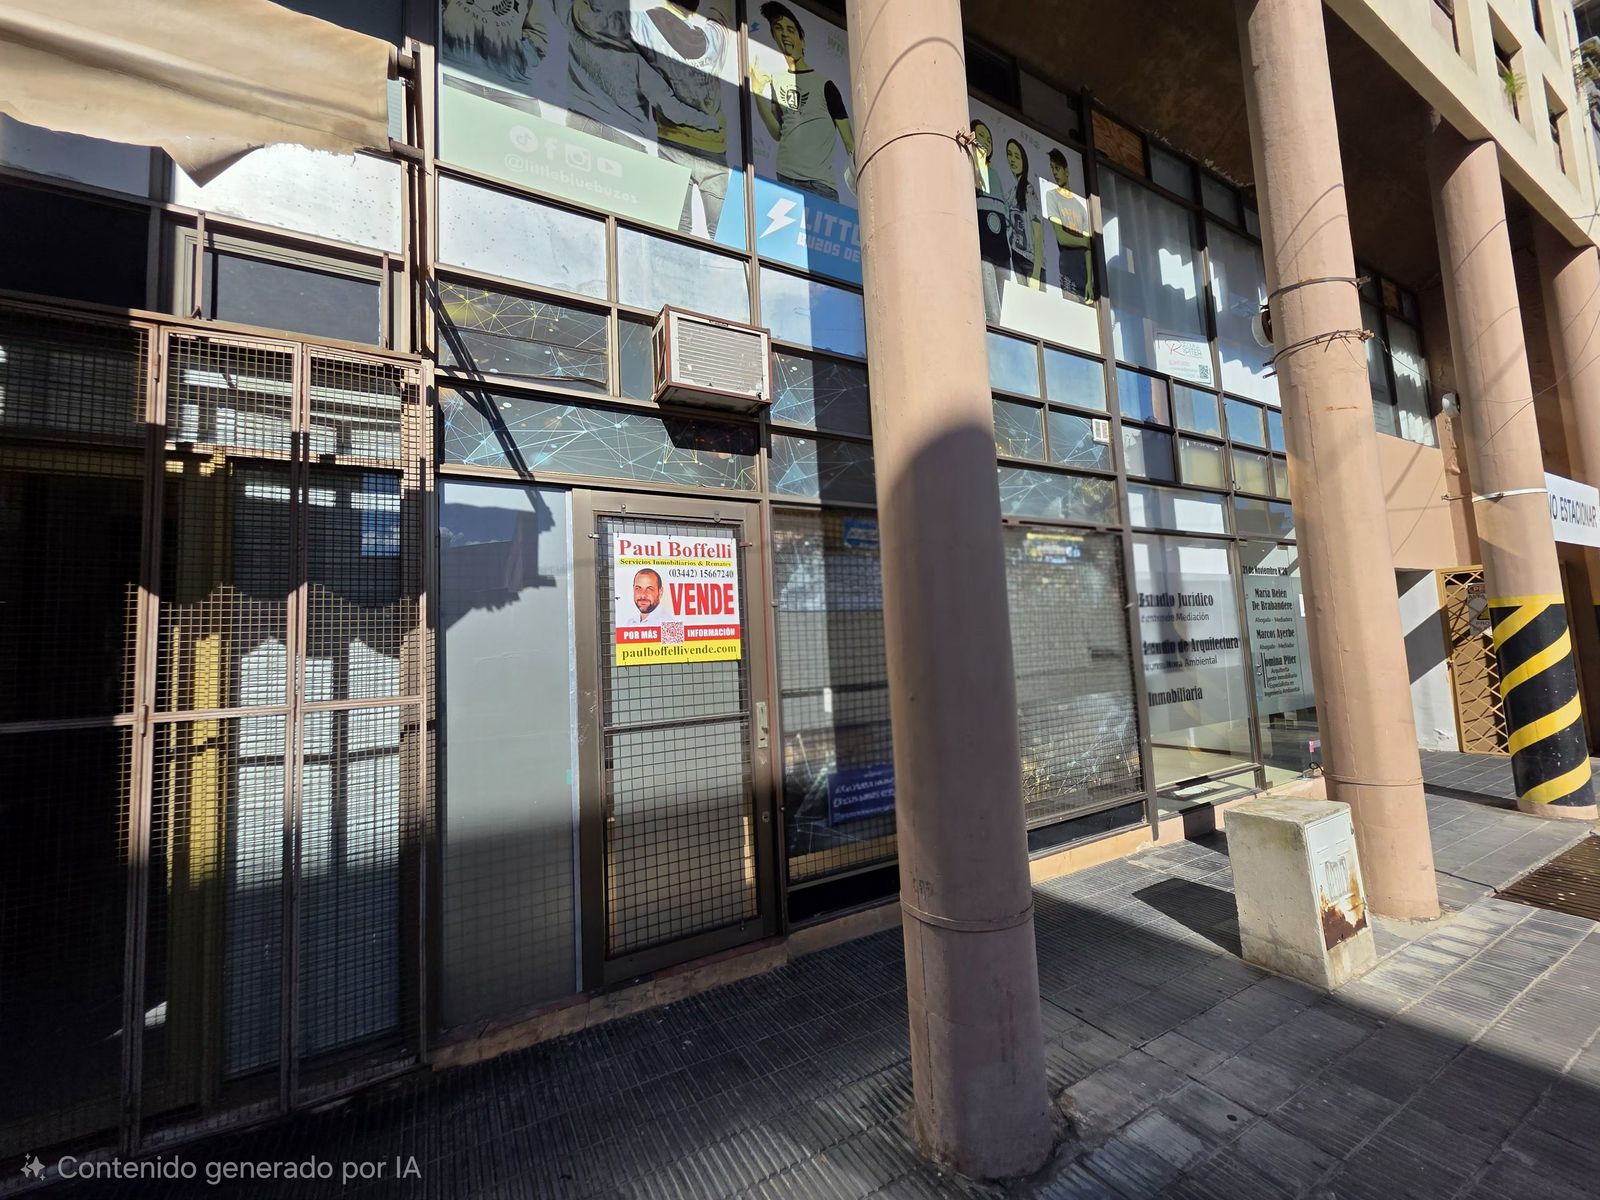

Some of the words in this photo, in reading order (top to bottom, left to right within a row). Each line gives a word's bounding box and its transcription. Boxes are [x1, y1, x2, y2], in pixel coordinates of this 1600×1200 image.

[1549, 494, 1558, 519] O
[1560, 496, 1598, 528] ESTACIONAR
[620, 539, 661, 556] Paul
[668, 541, 732, 558] Boffelli
[620, 558, 651, 566] Servicios
[653, 559, 696, 567] Inmobiliarios
[668, 569, 698, 579] (03442)
[700, 569, 734, 579] 15667240
[669, 583, 735, 616] VENDE
[1139, 592, 1175, 608] Estudio
[1178, 591, 1214, 608] Jurídico
[1252, 601, 1260, 611] De
[1176, 612, 1210, 621] Mediación
[623, 631, 640, 640] POR
[641, 629, 658, 639] MÁS
[687, 627, 736, 638] INFORMACIÓN
[1256, 629, 1276, 639] Marcos
[1277, 629, 1295, 639] Ayerbe
[1177, 639, 1189, 653] de
[1191, 637, 1239, 653] Arquitectura
[622, 645, 737, 660] paulboffellivende.com
[1184, 655, 1218, 667] Ambiental
[1148, 686, 1204, 707] Inmobiliaria
